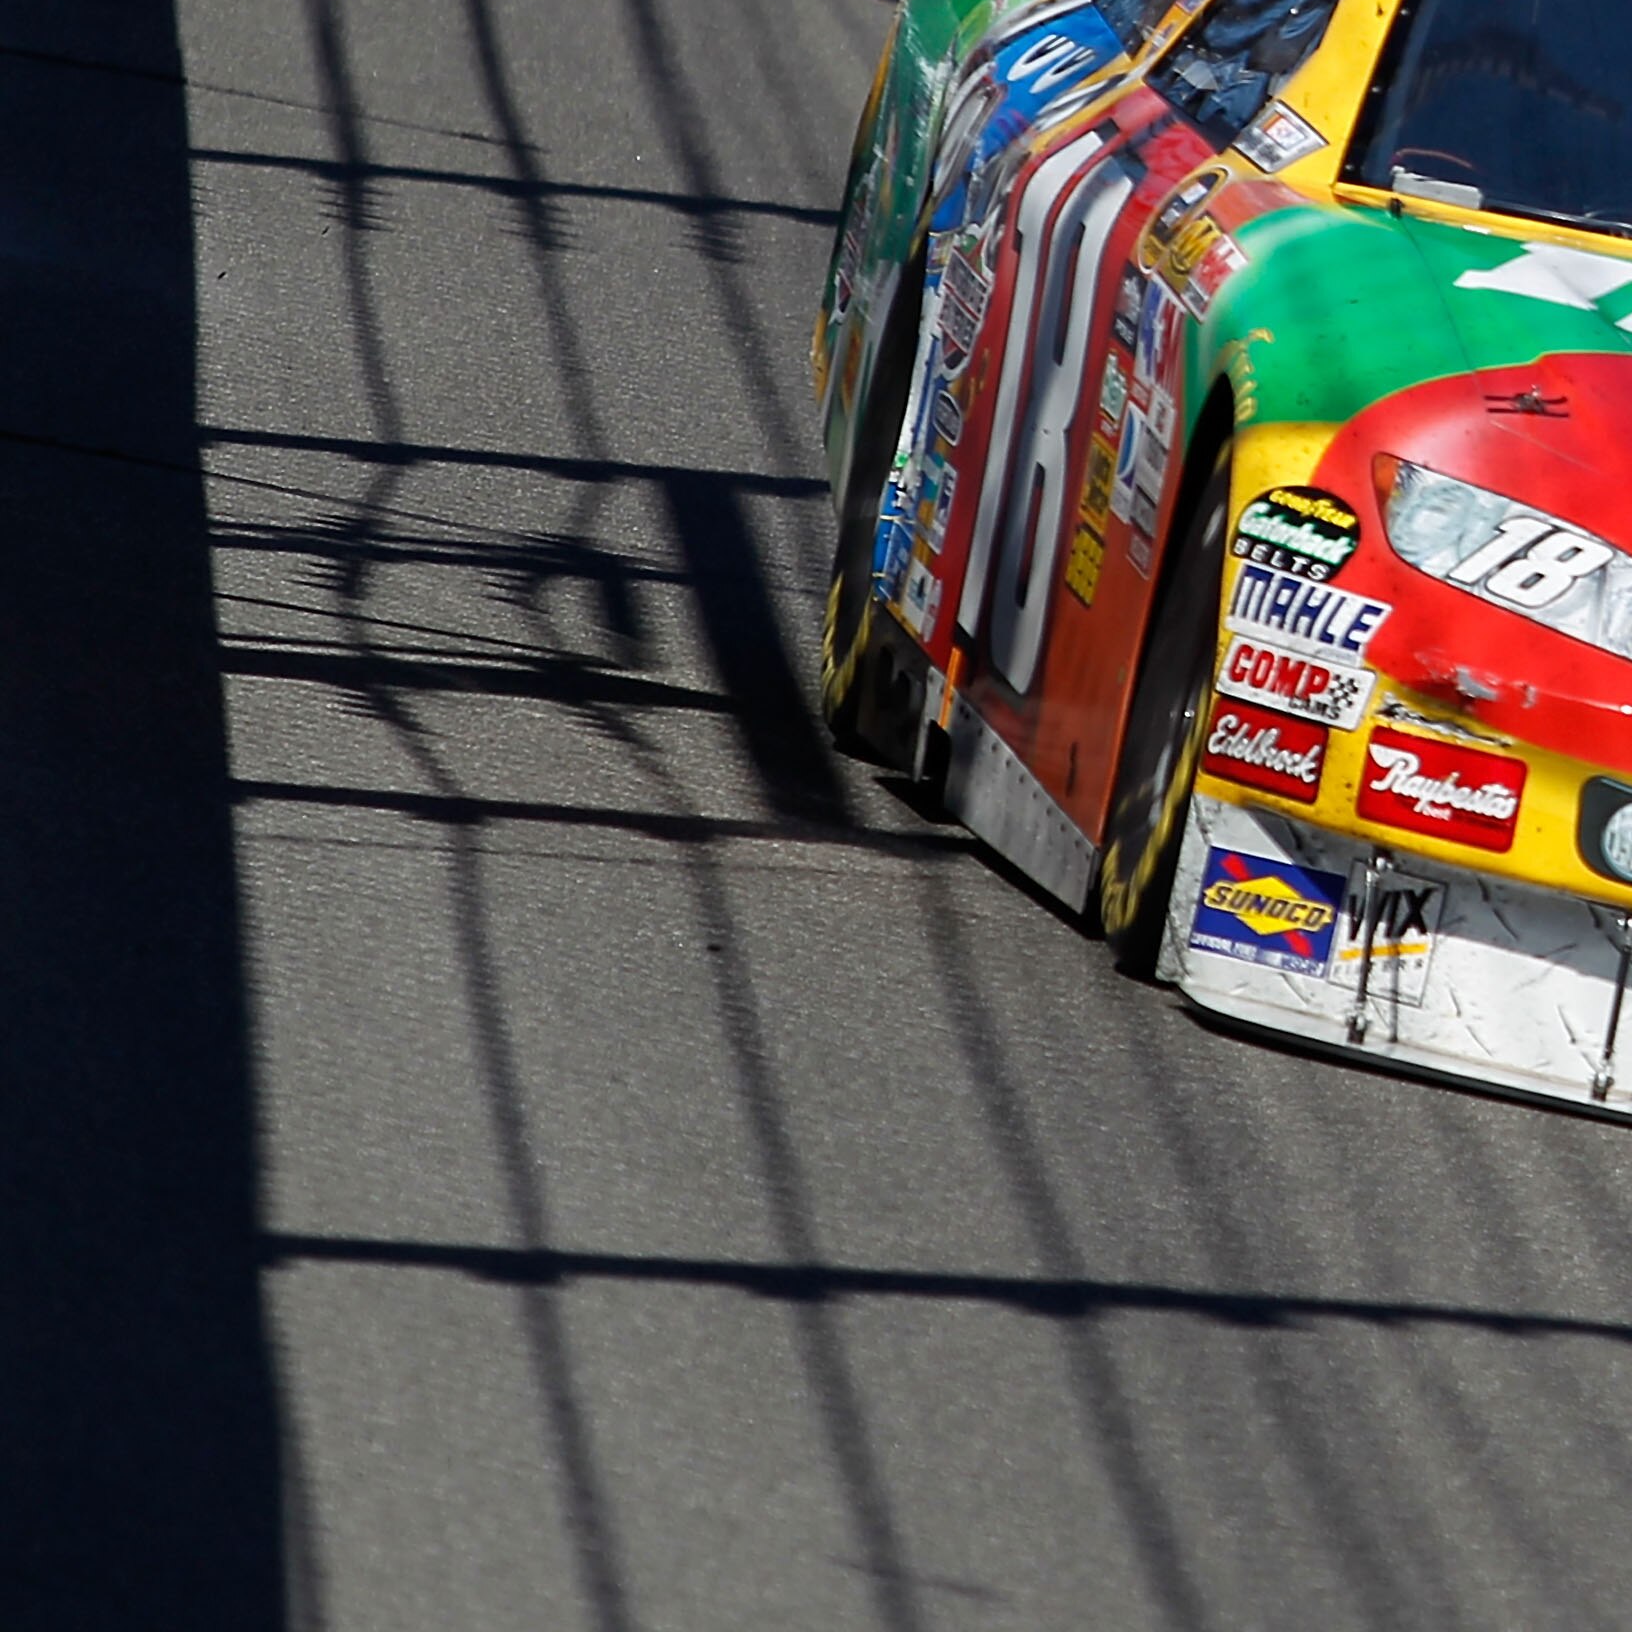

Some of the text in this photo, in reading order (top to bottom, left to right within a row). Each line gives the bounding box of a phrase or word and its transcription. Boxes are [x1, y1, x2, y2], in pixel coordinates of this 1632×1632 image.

[1233, 537, 1331, 581] BELTS
[1450, 515, 1616, 609] 18
[1231, 565, 1386, 651] MAHLE
[1229, 643, 1331, 700] COMP
[1207, 713, 1322, 783] Edelbrock
[1368, 743, 1518, 820] Raybestos
[1211, 885, 1329, 927] SUNOCO
[1349, 886, 1439, 941] WIX
